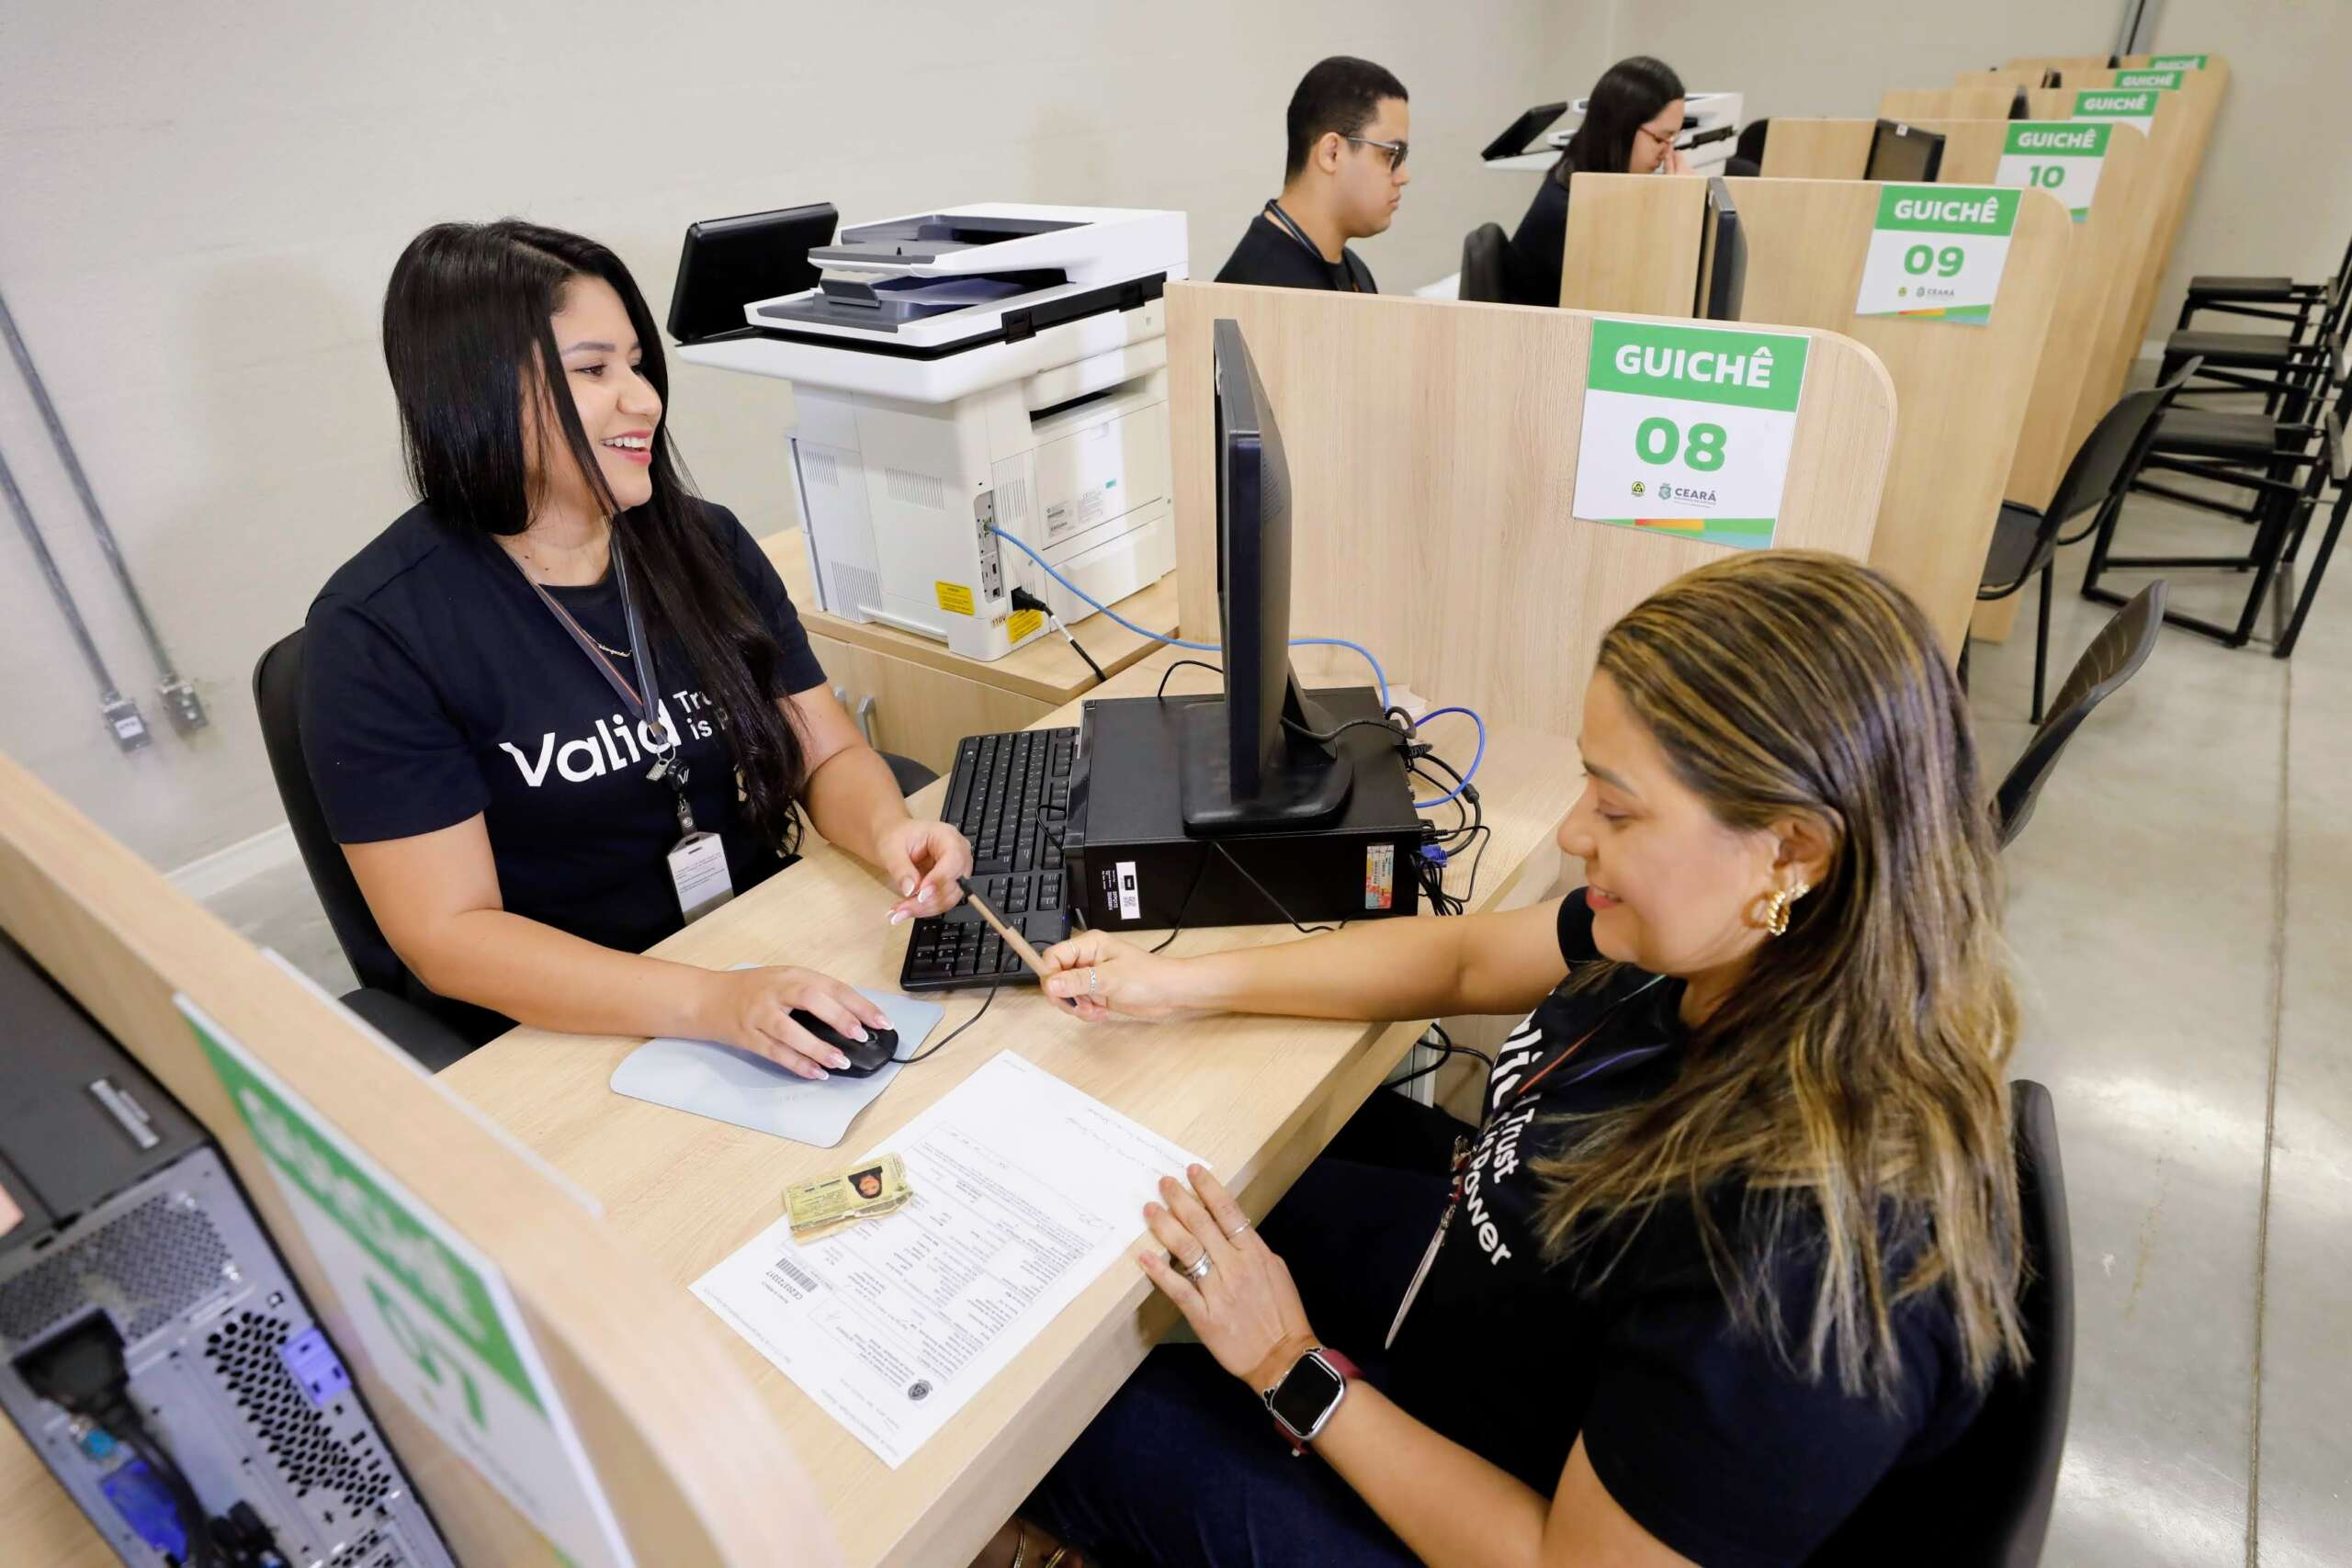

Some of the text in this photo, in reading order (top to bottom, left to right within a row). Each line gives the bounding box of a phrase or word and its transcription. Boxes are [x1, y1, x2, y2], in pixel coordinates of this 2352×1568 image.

[2121, 73, 2176, 86] GUICHÊ
[2084, 93, 2148, 110] GUICHÊ
[2017, 128, 2097, 148] GUICHÊ
[2030, 165, 2065, 188] 10
[1894, 197, 1999, 223] GUICHÊ
[1904, 244, 1964, 277] 09
[1615, 344, 1774, 389] GUICHÊ
[1634, 417, 1728, 472] 08
[1674, 488, 1717, 502] CEARÁ
[686, 717, 713, 740] is
[499, 698, 681, 787] Valid
[1493, 1108, 1535, 1185] Trust
